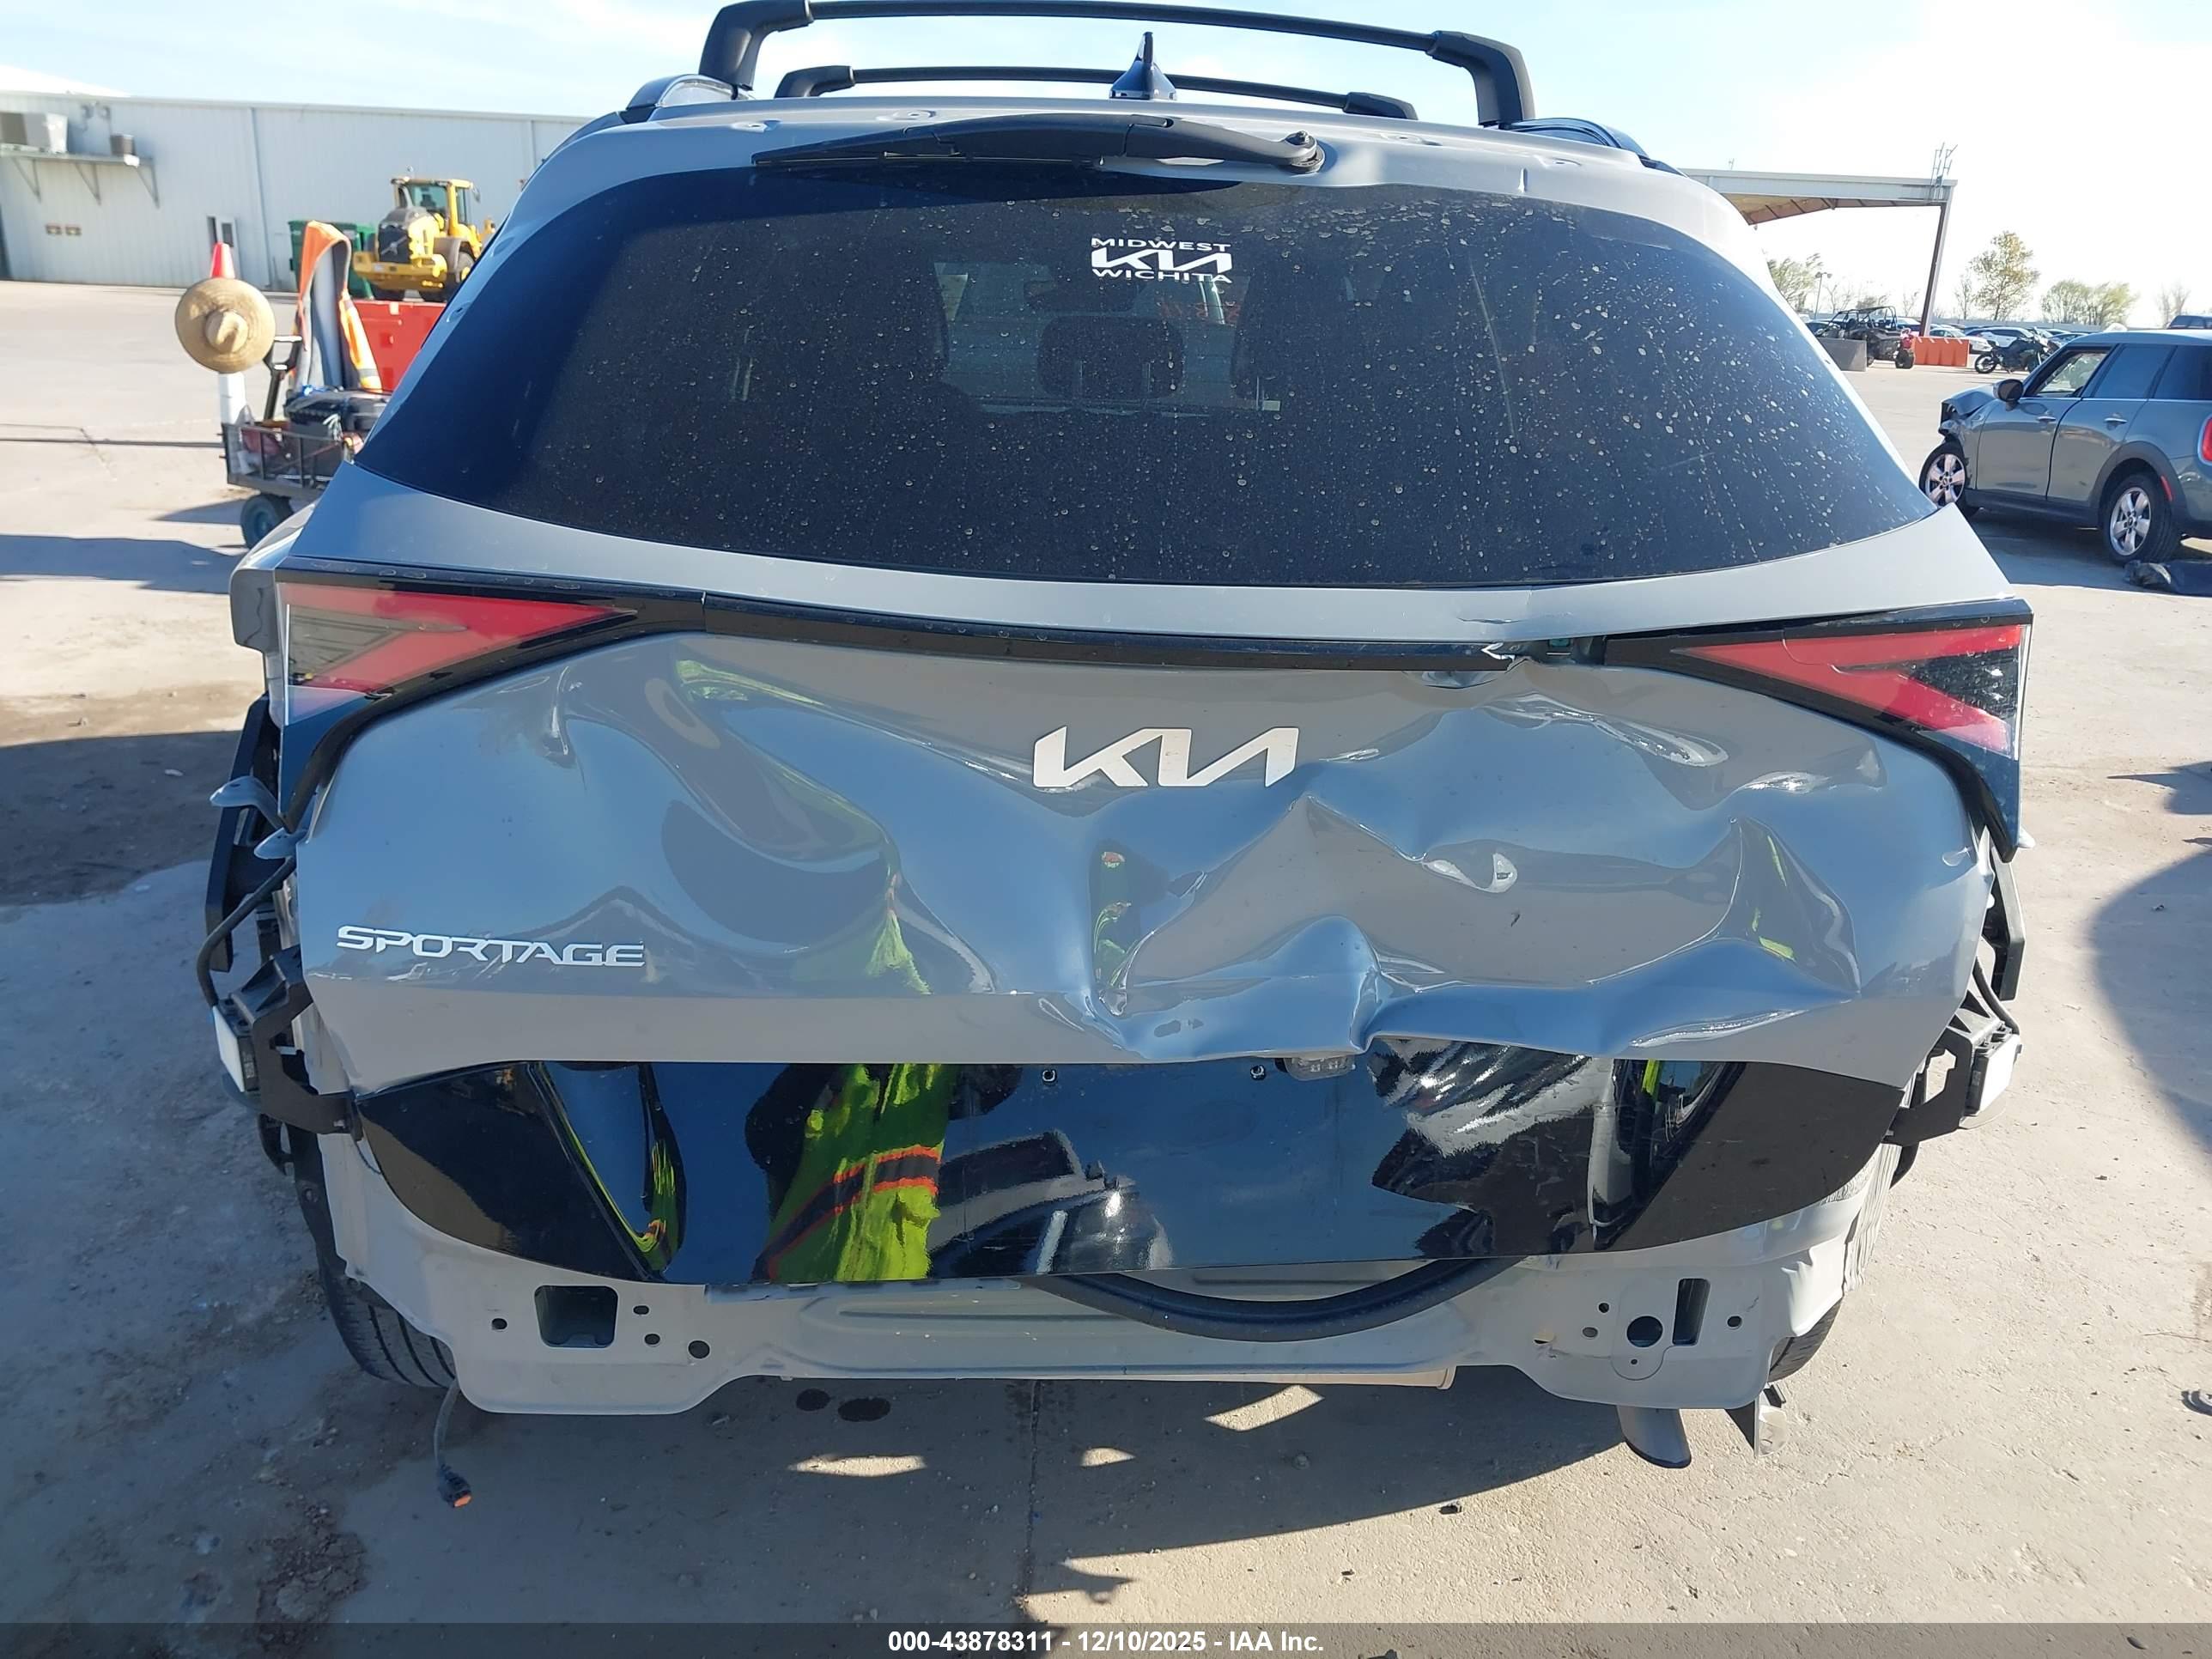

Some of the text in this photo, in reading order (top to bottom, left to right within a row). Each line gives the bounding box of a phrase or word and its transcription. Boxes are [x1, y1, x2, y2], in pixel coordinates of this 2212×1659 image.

[1091, 238, 1231, 252] MIDWEST
[1091, 246, 1232, 274] KIA
[1092, 268, 1232, 283] WICHITA
[1033, 726, 1299, 787] KIA
[336, 925, 646, 967] SPORTAGE
